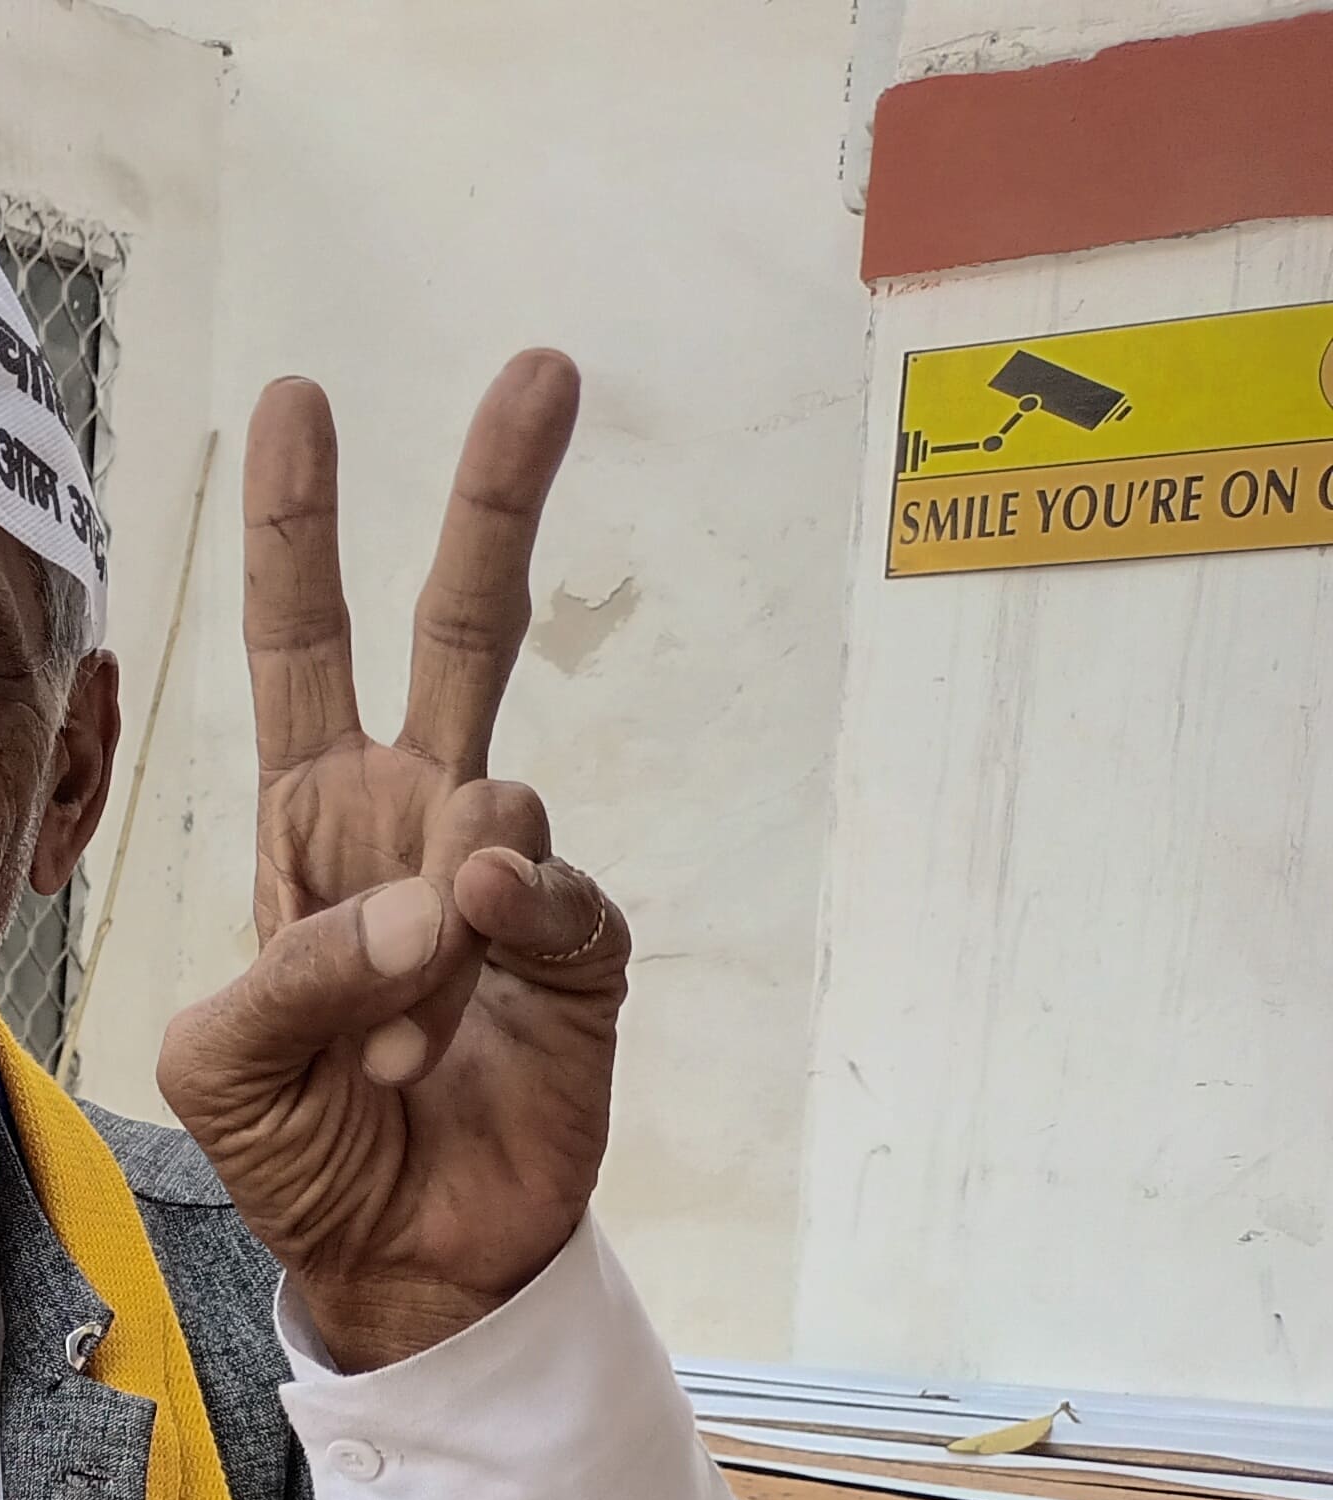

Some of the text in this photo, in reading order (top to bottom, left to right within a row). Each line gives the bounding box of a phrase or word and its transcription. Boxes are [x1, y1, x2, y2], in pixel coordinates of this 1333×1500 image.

[899, 491, 1020, 546] SMILE
[1035, 474, 1204, 534] YOU'RE
[1220, 466, 1299, 519] ON
